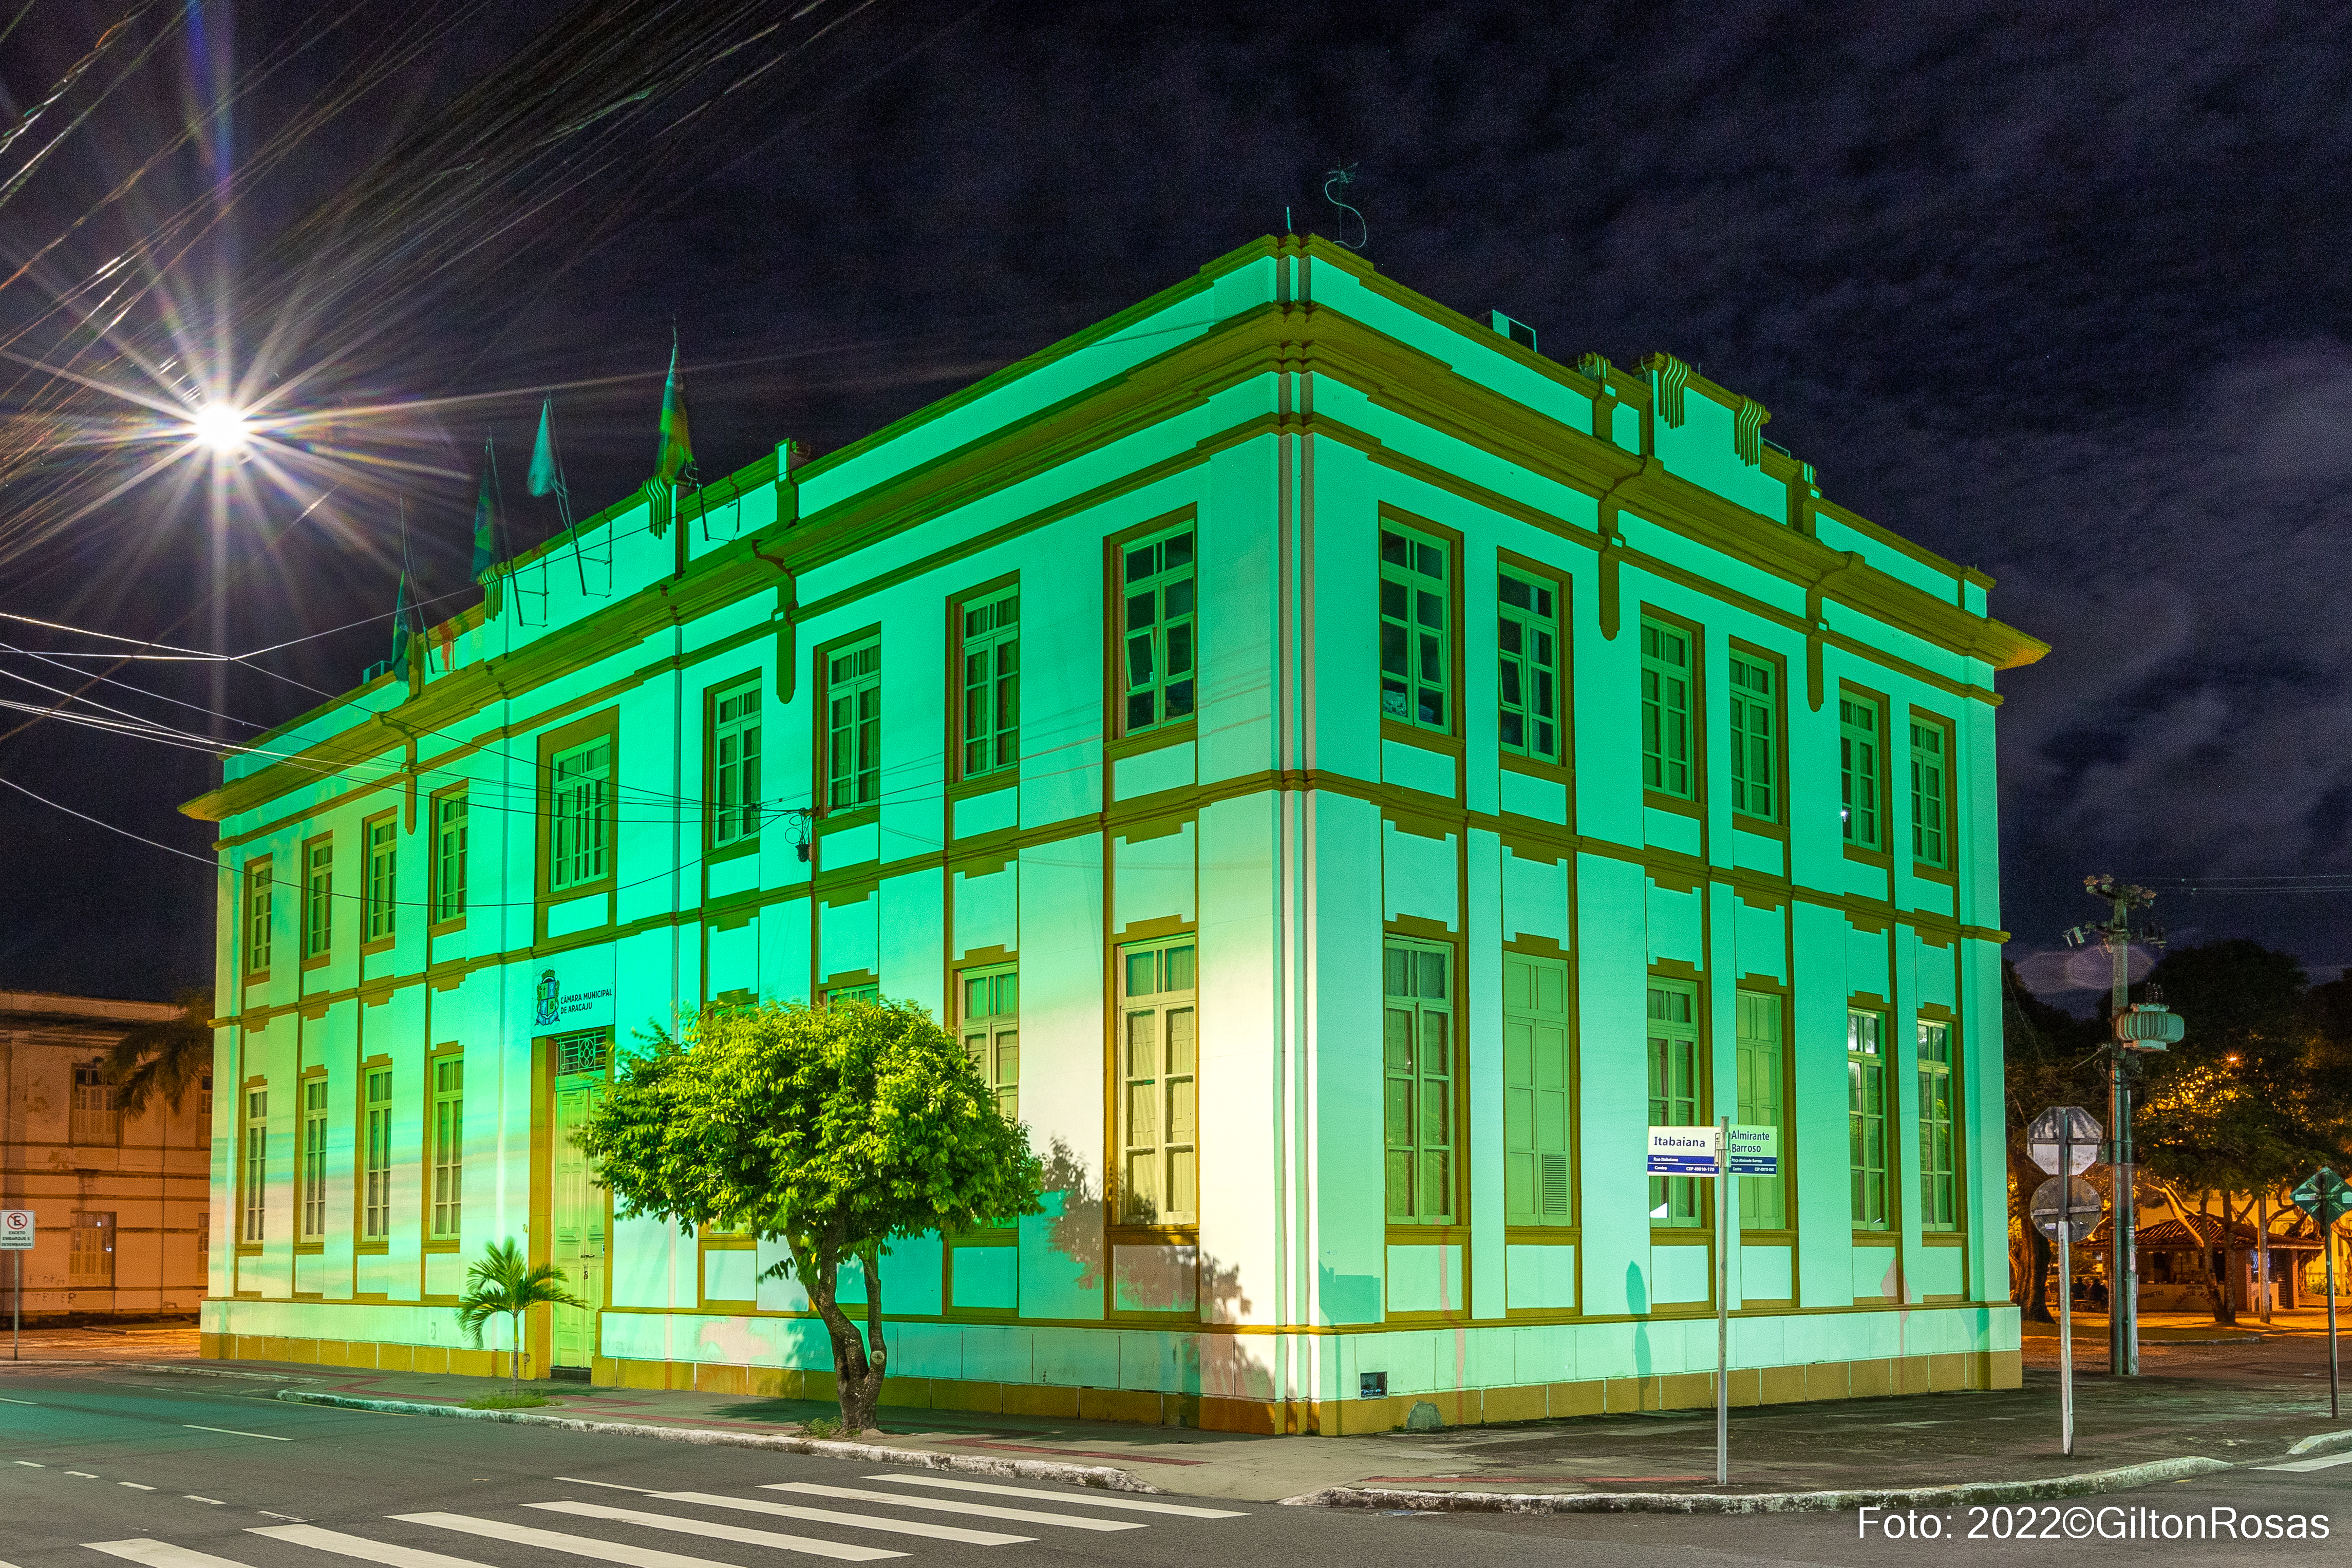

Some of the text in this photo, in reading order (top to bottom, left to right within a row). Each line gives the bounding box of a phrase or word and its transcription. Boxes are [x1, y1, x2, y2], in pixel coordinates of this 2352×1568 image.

[584, 988, 612, 1000] MUNICIPAL
[560, 1002, 592, 1014] DE ARACAJU
[1732, 1129, 1770, 1140] Almirante
[1654, 1136, 1705, 1147] Itabaiana
[1732, 1144, 1761, 1153] Barroso
